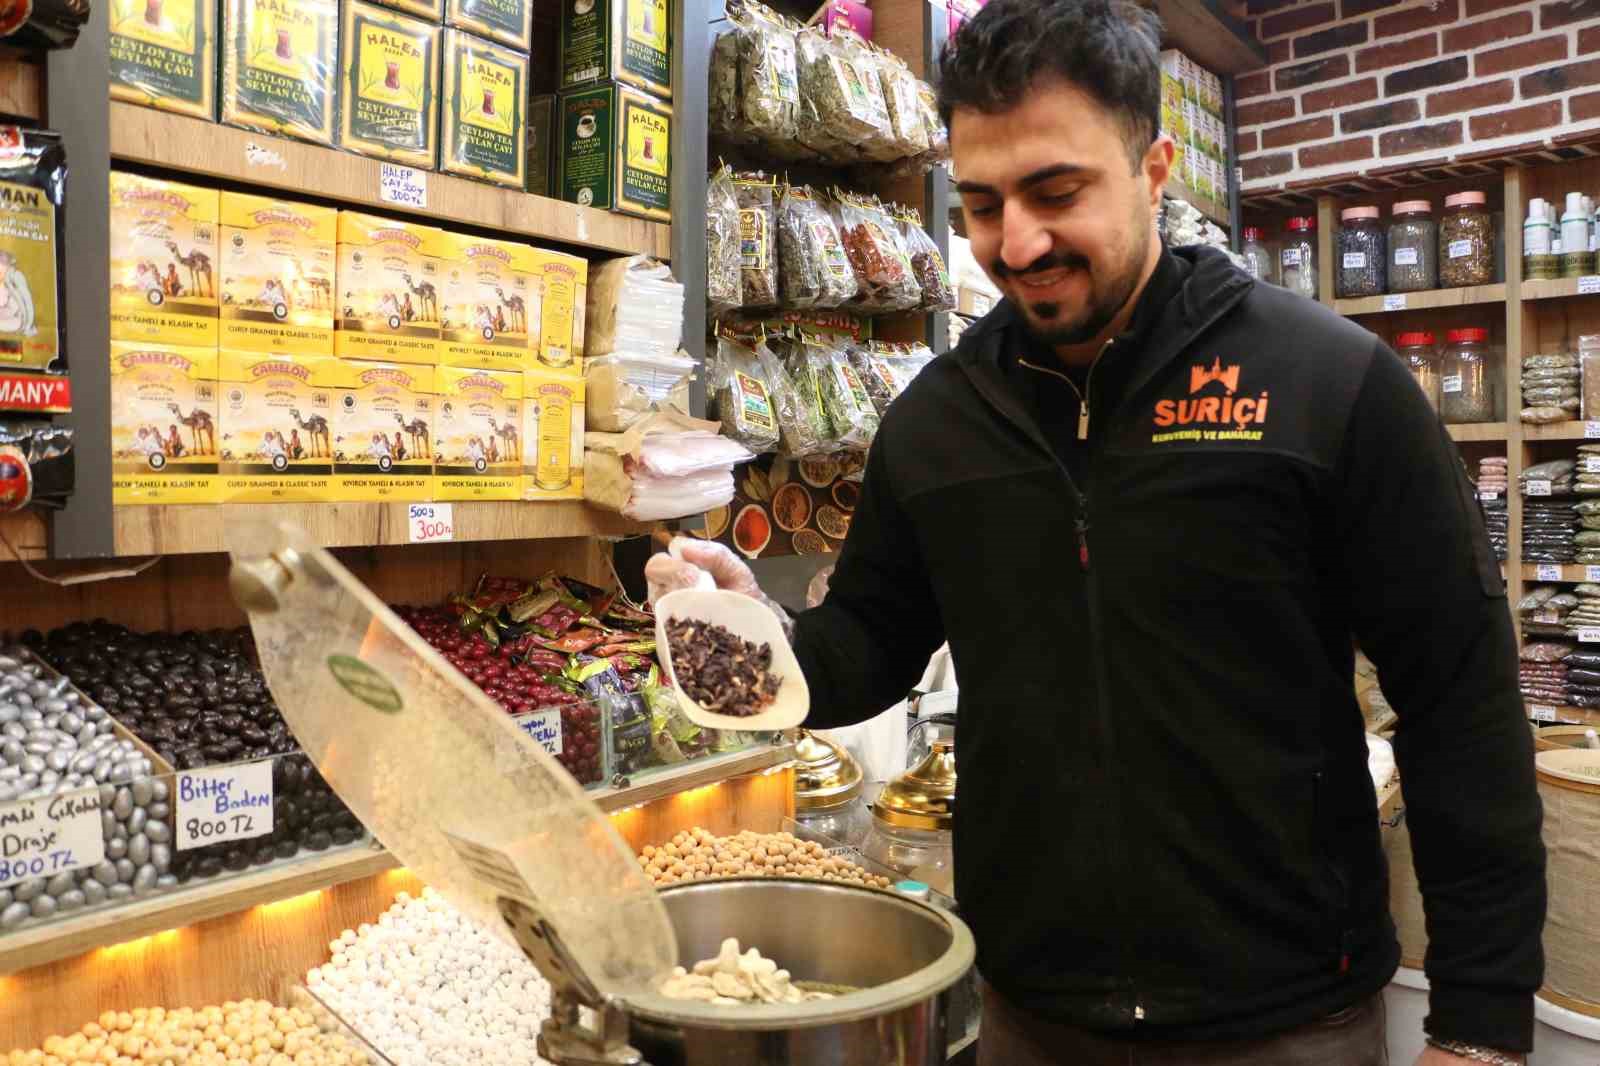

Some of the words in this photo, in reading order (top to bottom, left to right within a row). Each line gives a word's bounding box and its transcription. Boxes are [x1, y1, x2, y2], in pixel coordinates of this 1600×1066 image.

[110, 36, 166, 59] CEYLON
[169, 51, 193, 65] TEA
[367, 34, 421, 58] HALEP
[110, 47, 161, 69] SEYLAN
[246, 69, 295, 89] CEYLON
[246, 79, 290, 98] SEYLAN
[358, 101, 401, 117] CEYLON
[460, 124, 496, 141] CEYLON
[631, 114, 666, 133] HALEP
[252, 363, 309, 381] CAMELON
[0, 381, 55, 404] MANY
[180, 775, 234, 802] Bitter
[186, 818, 226, 840] 800
[230, 814, 254, 834] TL
[3, 828, 57, 857] Draje
[0, 857, 44, 881] 800
[49, 848, 78, 869] TL
